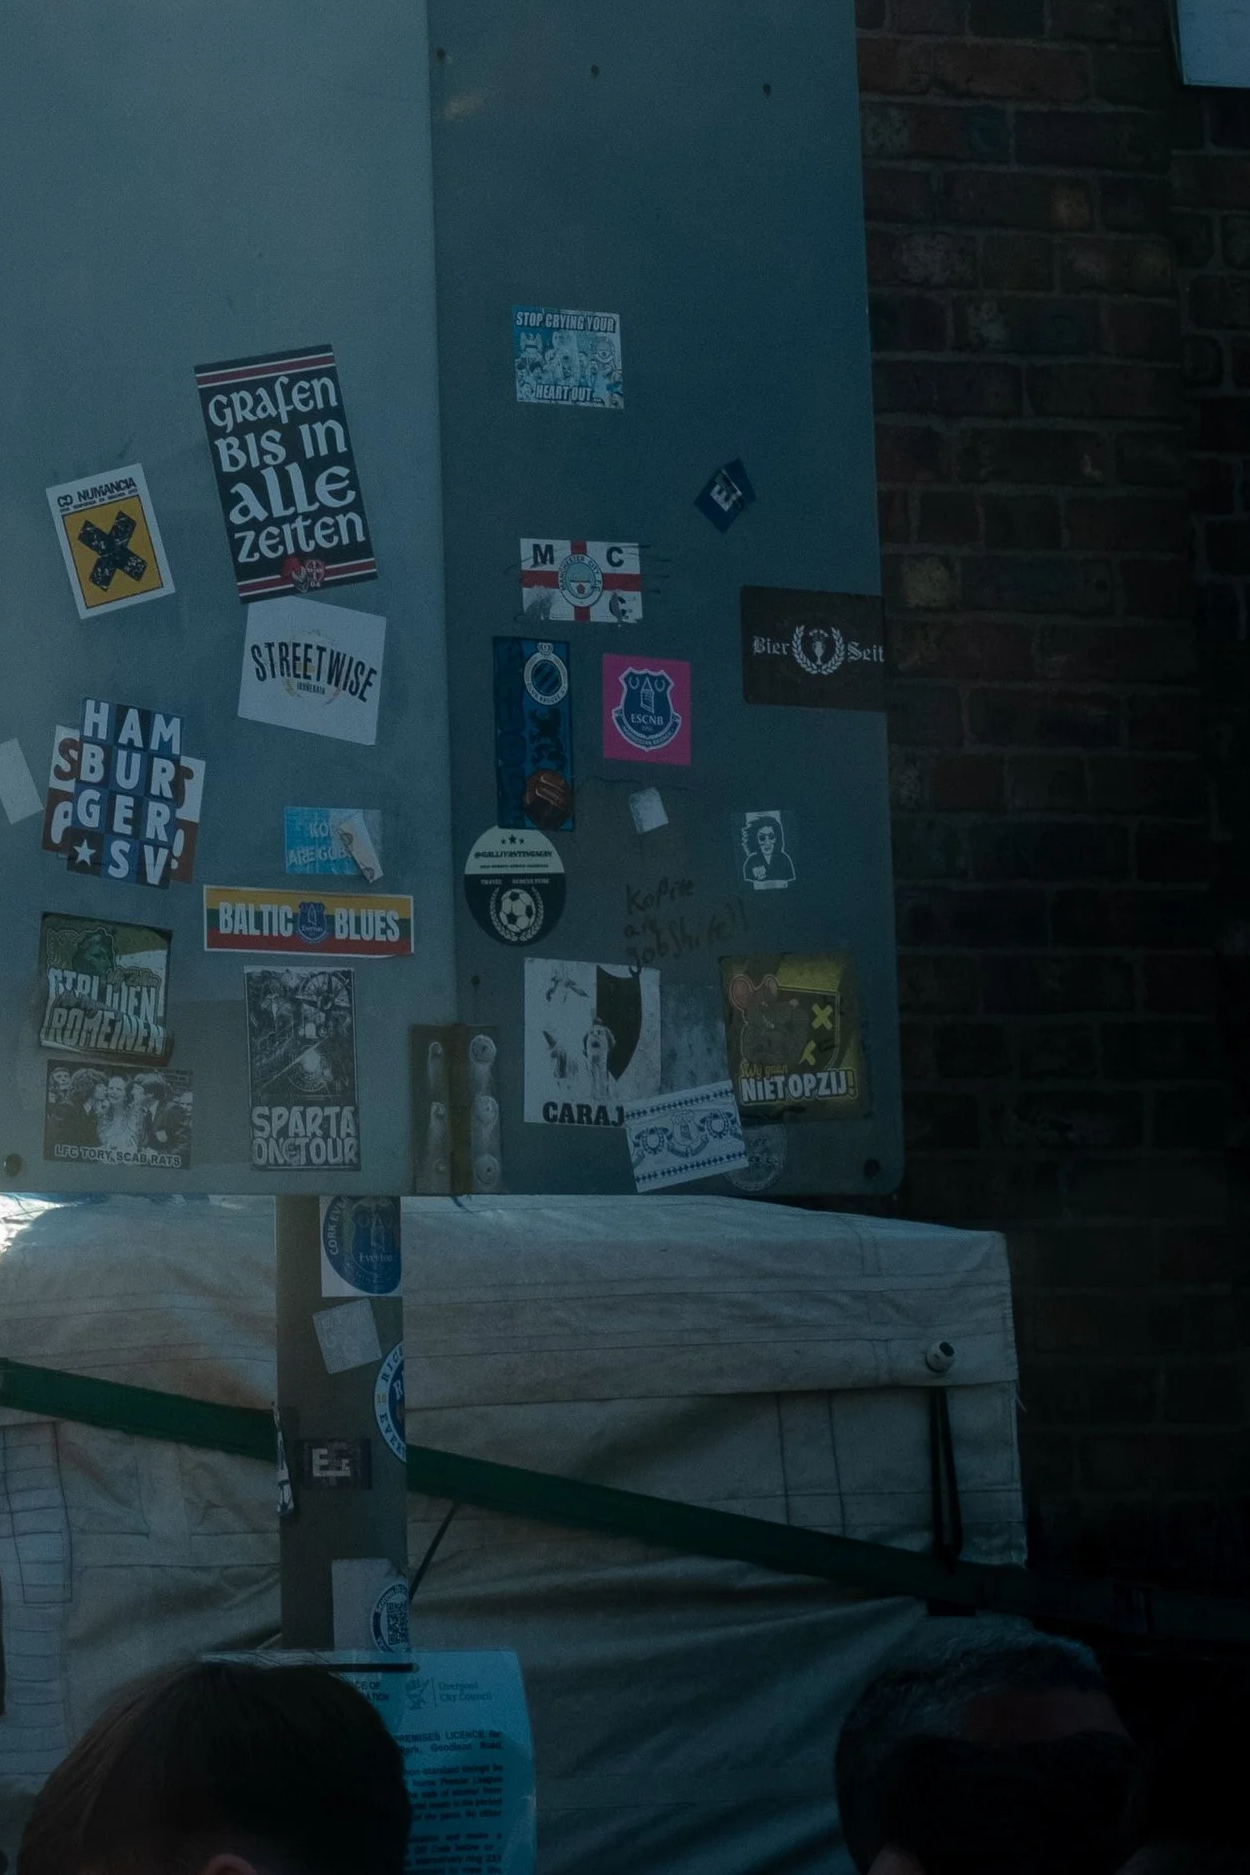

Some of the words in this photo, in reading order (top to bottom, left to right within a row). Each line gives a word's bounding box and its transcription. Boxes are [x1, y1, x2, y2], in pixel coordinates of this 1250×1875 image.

[515, 311, 543, 327] STOP
[545, 313, 585, 331] CRYING
[587, 316, 616, 334] YOUR
[536, 384, 569, 400] HEART
[77, 477, 138, 502] NUMANCIA
[533, 543, 554, 564] M
[607, 546, 624, 567] C
[752, 635, 791, 655] Bier
[847, 641, 885, 663] Seit
[251, 642, 377, 702] STREETWISE
[83, 699, 181, 755] HAM
[630, 713, 664, 725] ESCNB
[107, 840, 170, 885] SV
[218, 901, 293, 937] BALTIC
[334, 908, 400, 942] BLUES
[252, 1106, 357, 1139] SPARTA
[54, 1143, 79, 1158] LFC
[149, 1154, 182, 1168] RATS
[327, 1224, 339, 1255] CORK
[439, 1681, 479, 1692] Liverpool
[440, 1693, 457, 1702] City
[459, 1692, 493, 1702] Council
[445, 1731, 485, 1741] LICENCE
